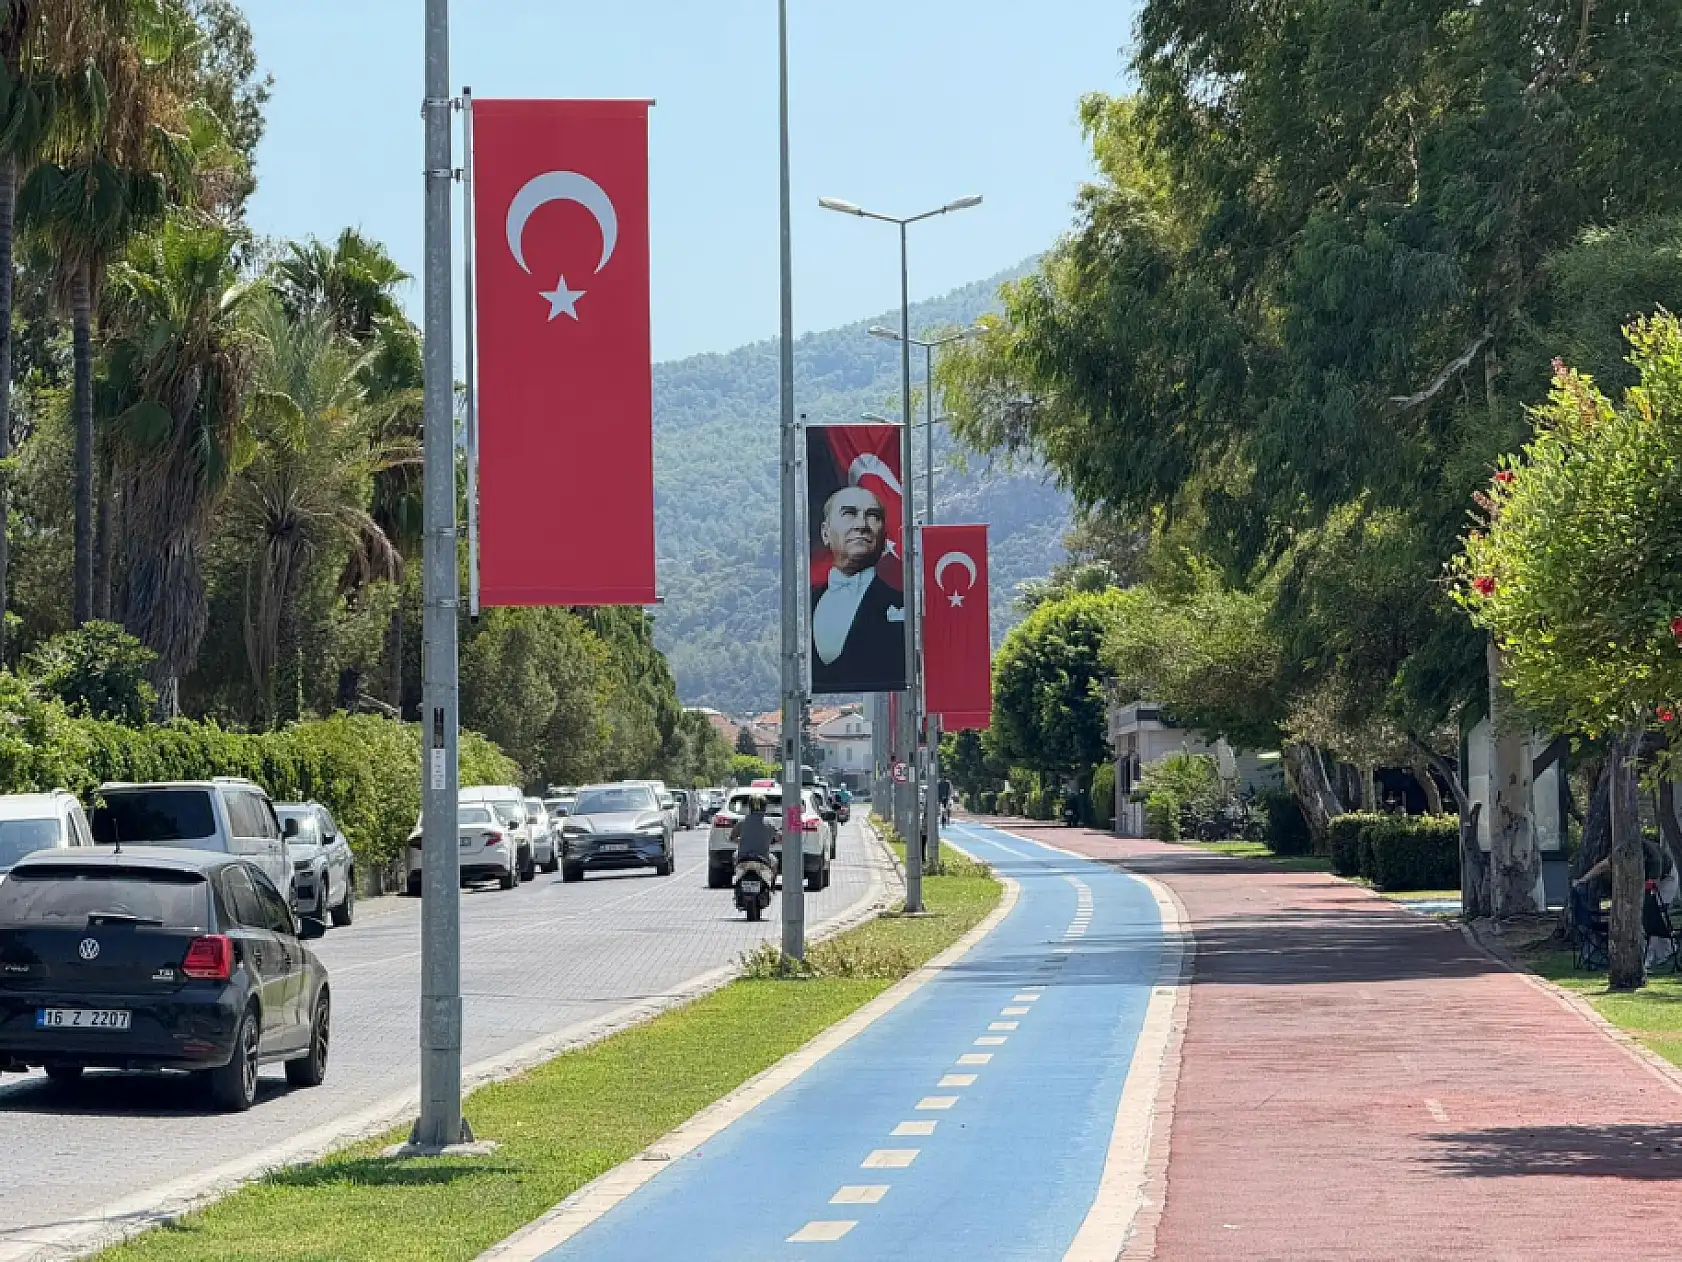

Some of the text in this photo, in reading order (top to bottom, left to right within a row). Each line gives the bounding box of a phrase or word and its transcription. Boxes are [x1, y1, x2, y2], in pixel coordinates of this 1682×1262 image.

[47, 1011, 128, 1027] 16 Z 2207
